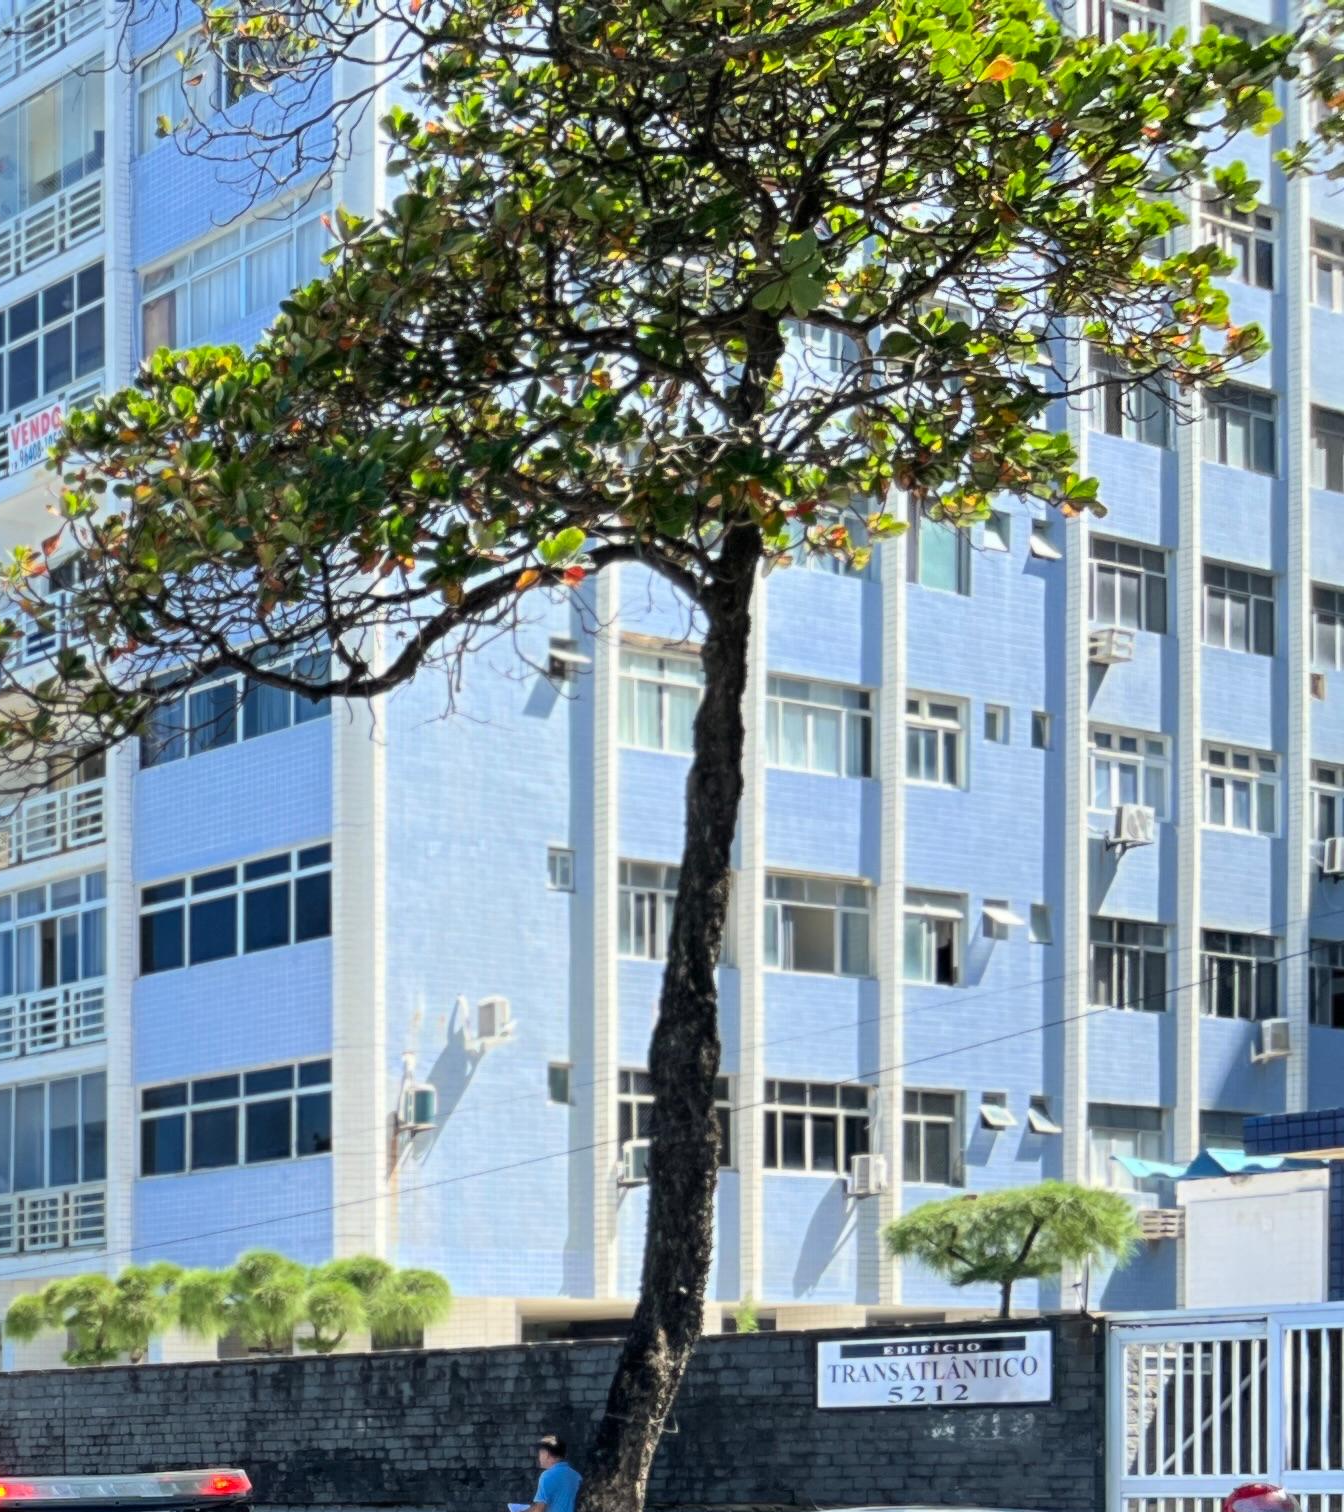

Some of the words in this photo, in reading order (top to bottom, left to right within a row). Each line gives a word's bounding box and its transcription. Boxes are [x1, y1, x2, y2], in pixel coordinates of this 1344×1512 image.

[11, 405, 64, 451] VENDO
[883, 1342, 981, 1355] EDIFÍCIO
[828, 1356, 1038, 1384] TRANSATLÂNTICO
[888, 1384, 969, 1404] 5212
